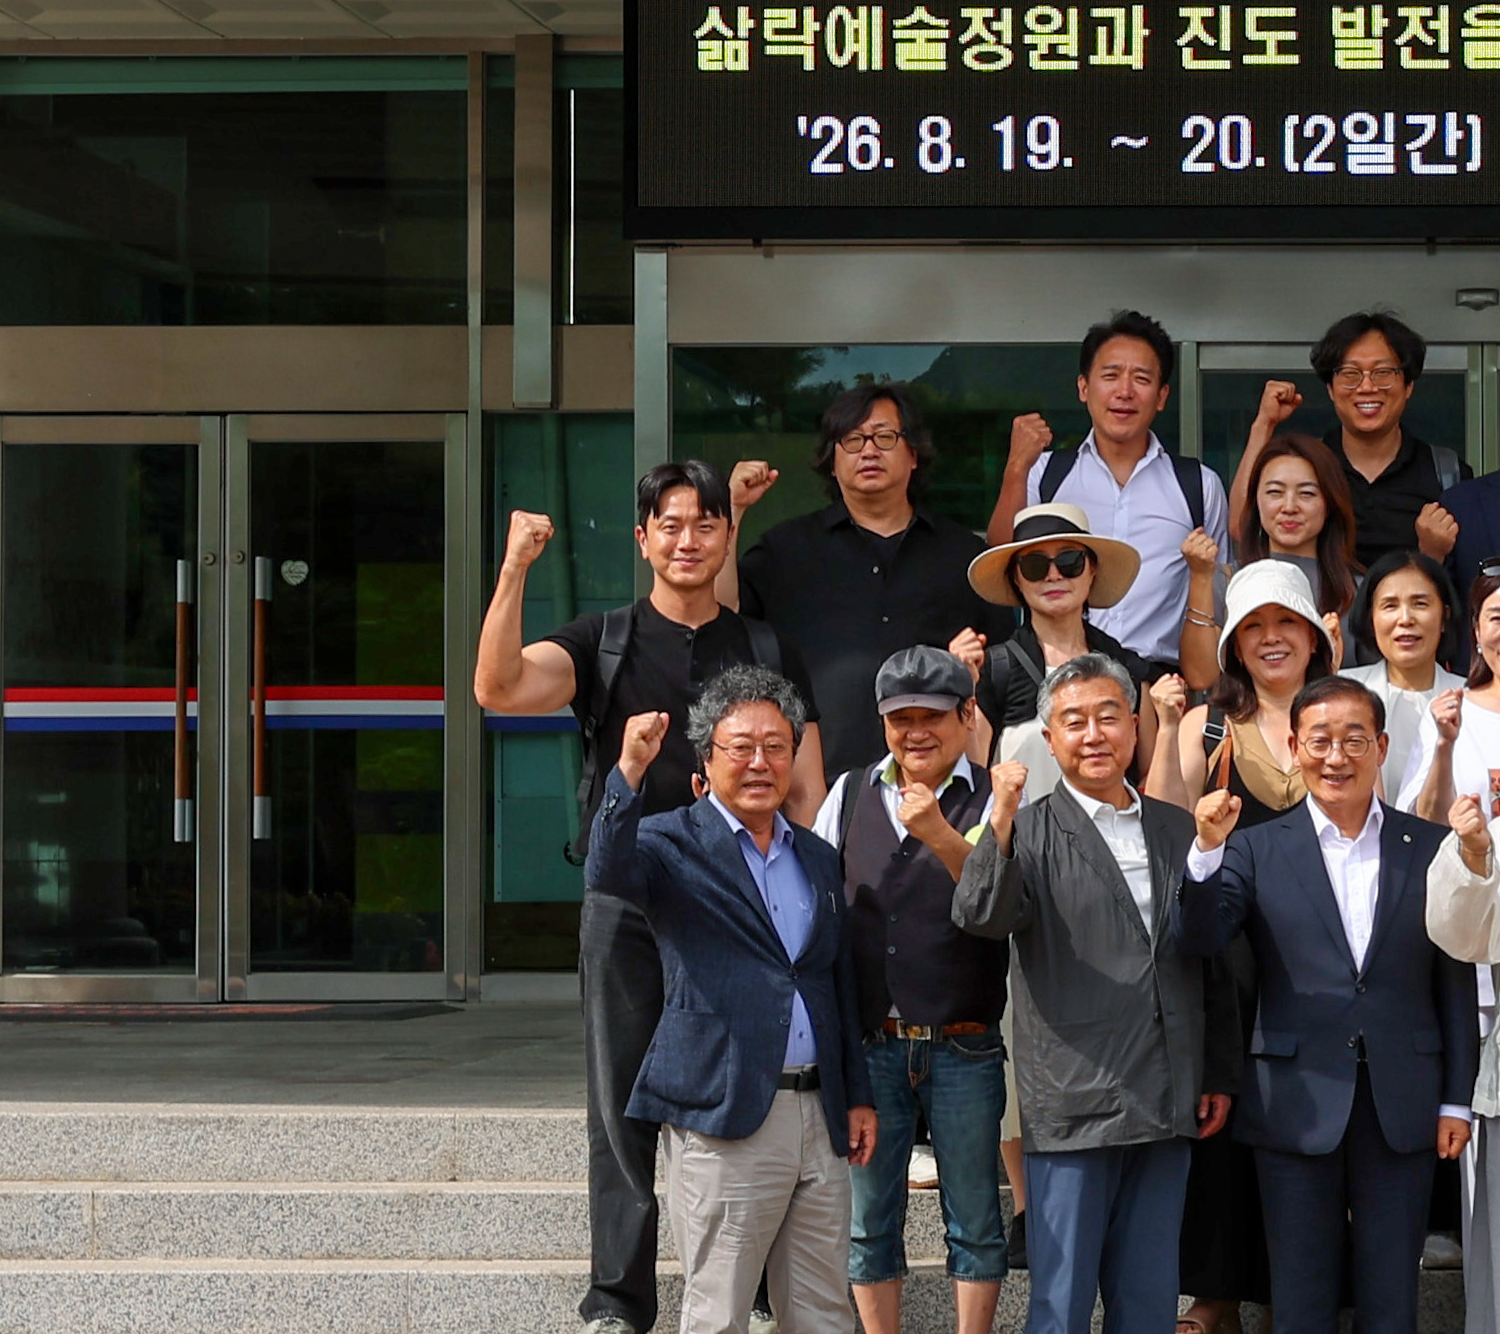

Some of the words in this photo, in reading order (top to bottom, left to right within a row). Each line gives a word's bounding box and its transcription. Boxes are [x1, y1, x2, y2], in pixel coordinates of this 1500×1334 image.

[694, 4, 1151, 71] 삶락예술정원과
[1176, 4, 1300, 70] 진도
[797, 115, 895, 174] '26.
[917, 115, 966, 173] 8.
[992, 115, 1074, 171] 19.
